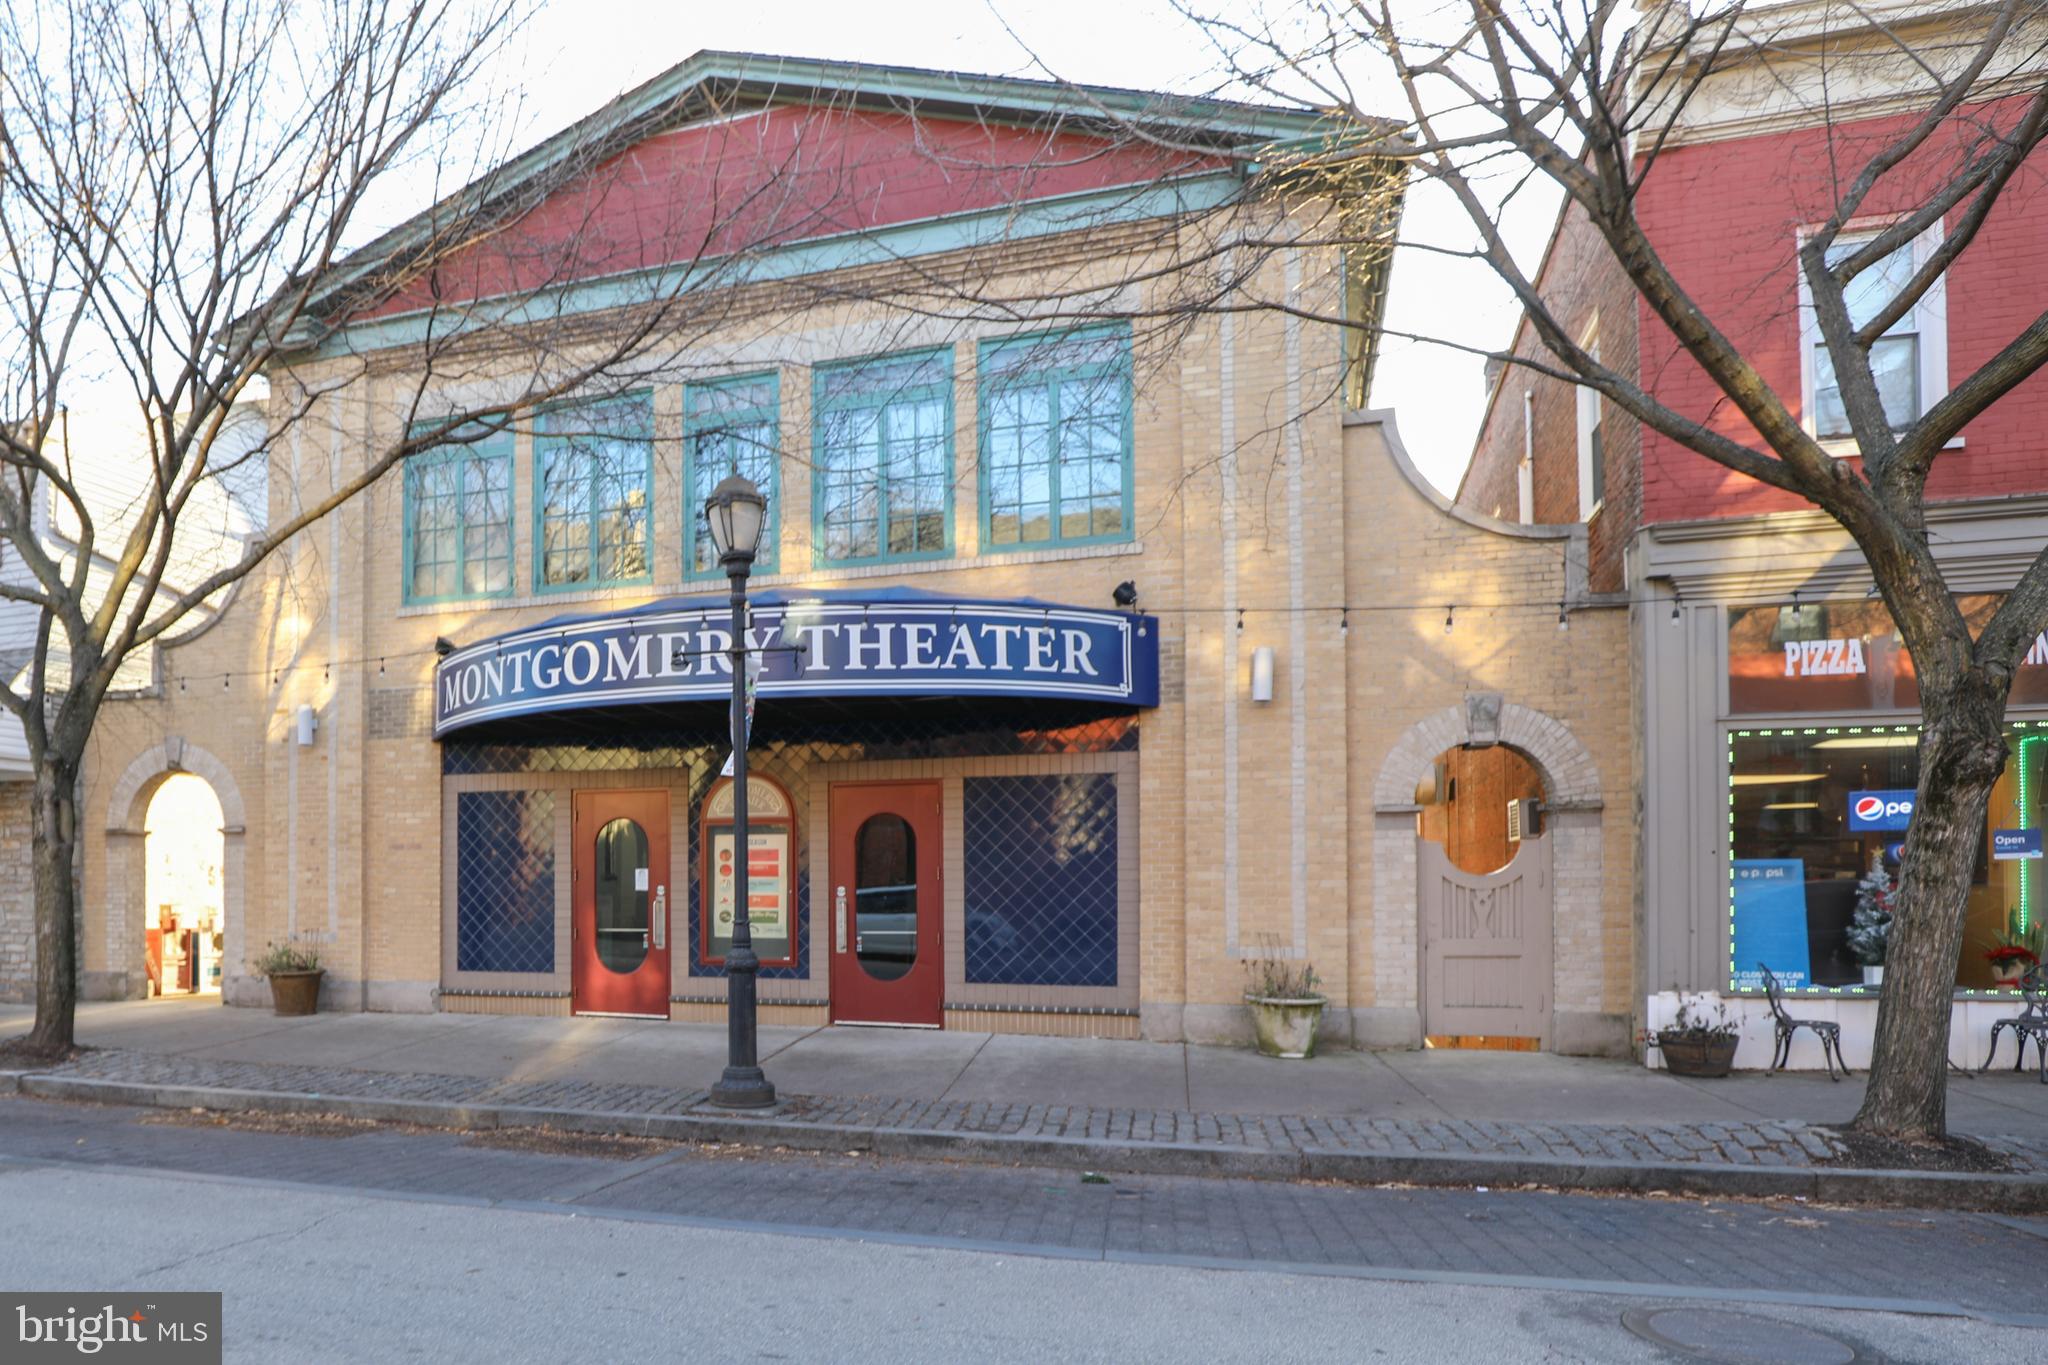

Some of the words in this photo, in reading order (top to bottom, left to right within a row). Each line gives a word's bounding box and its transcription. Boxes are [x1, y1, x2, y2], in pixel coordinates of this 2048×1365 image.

[443, 627, 780, 714] MONTGOMERY
[796, 622, 1099, 676] THEATER
[1784, 638, 1867, 677] PIZZA
[1995, 835, 2026, 847] Open
